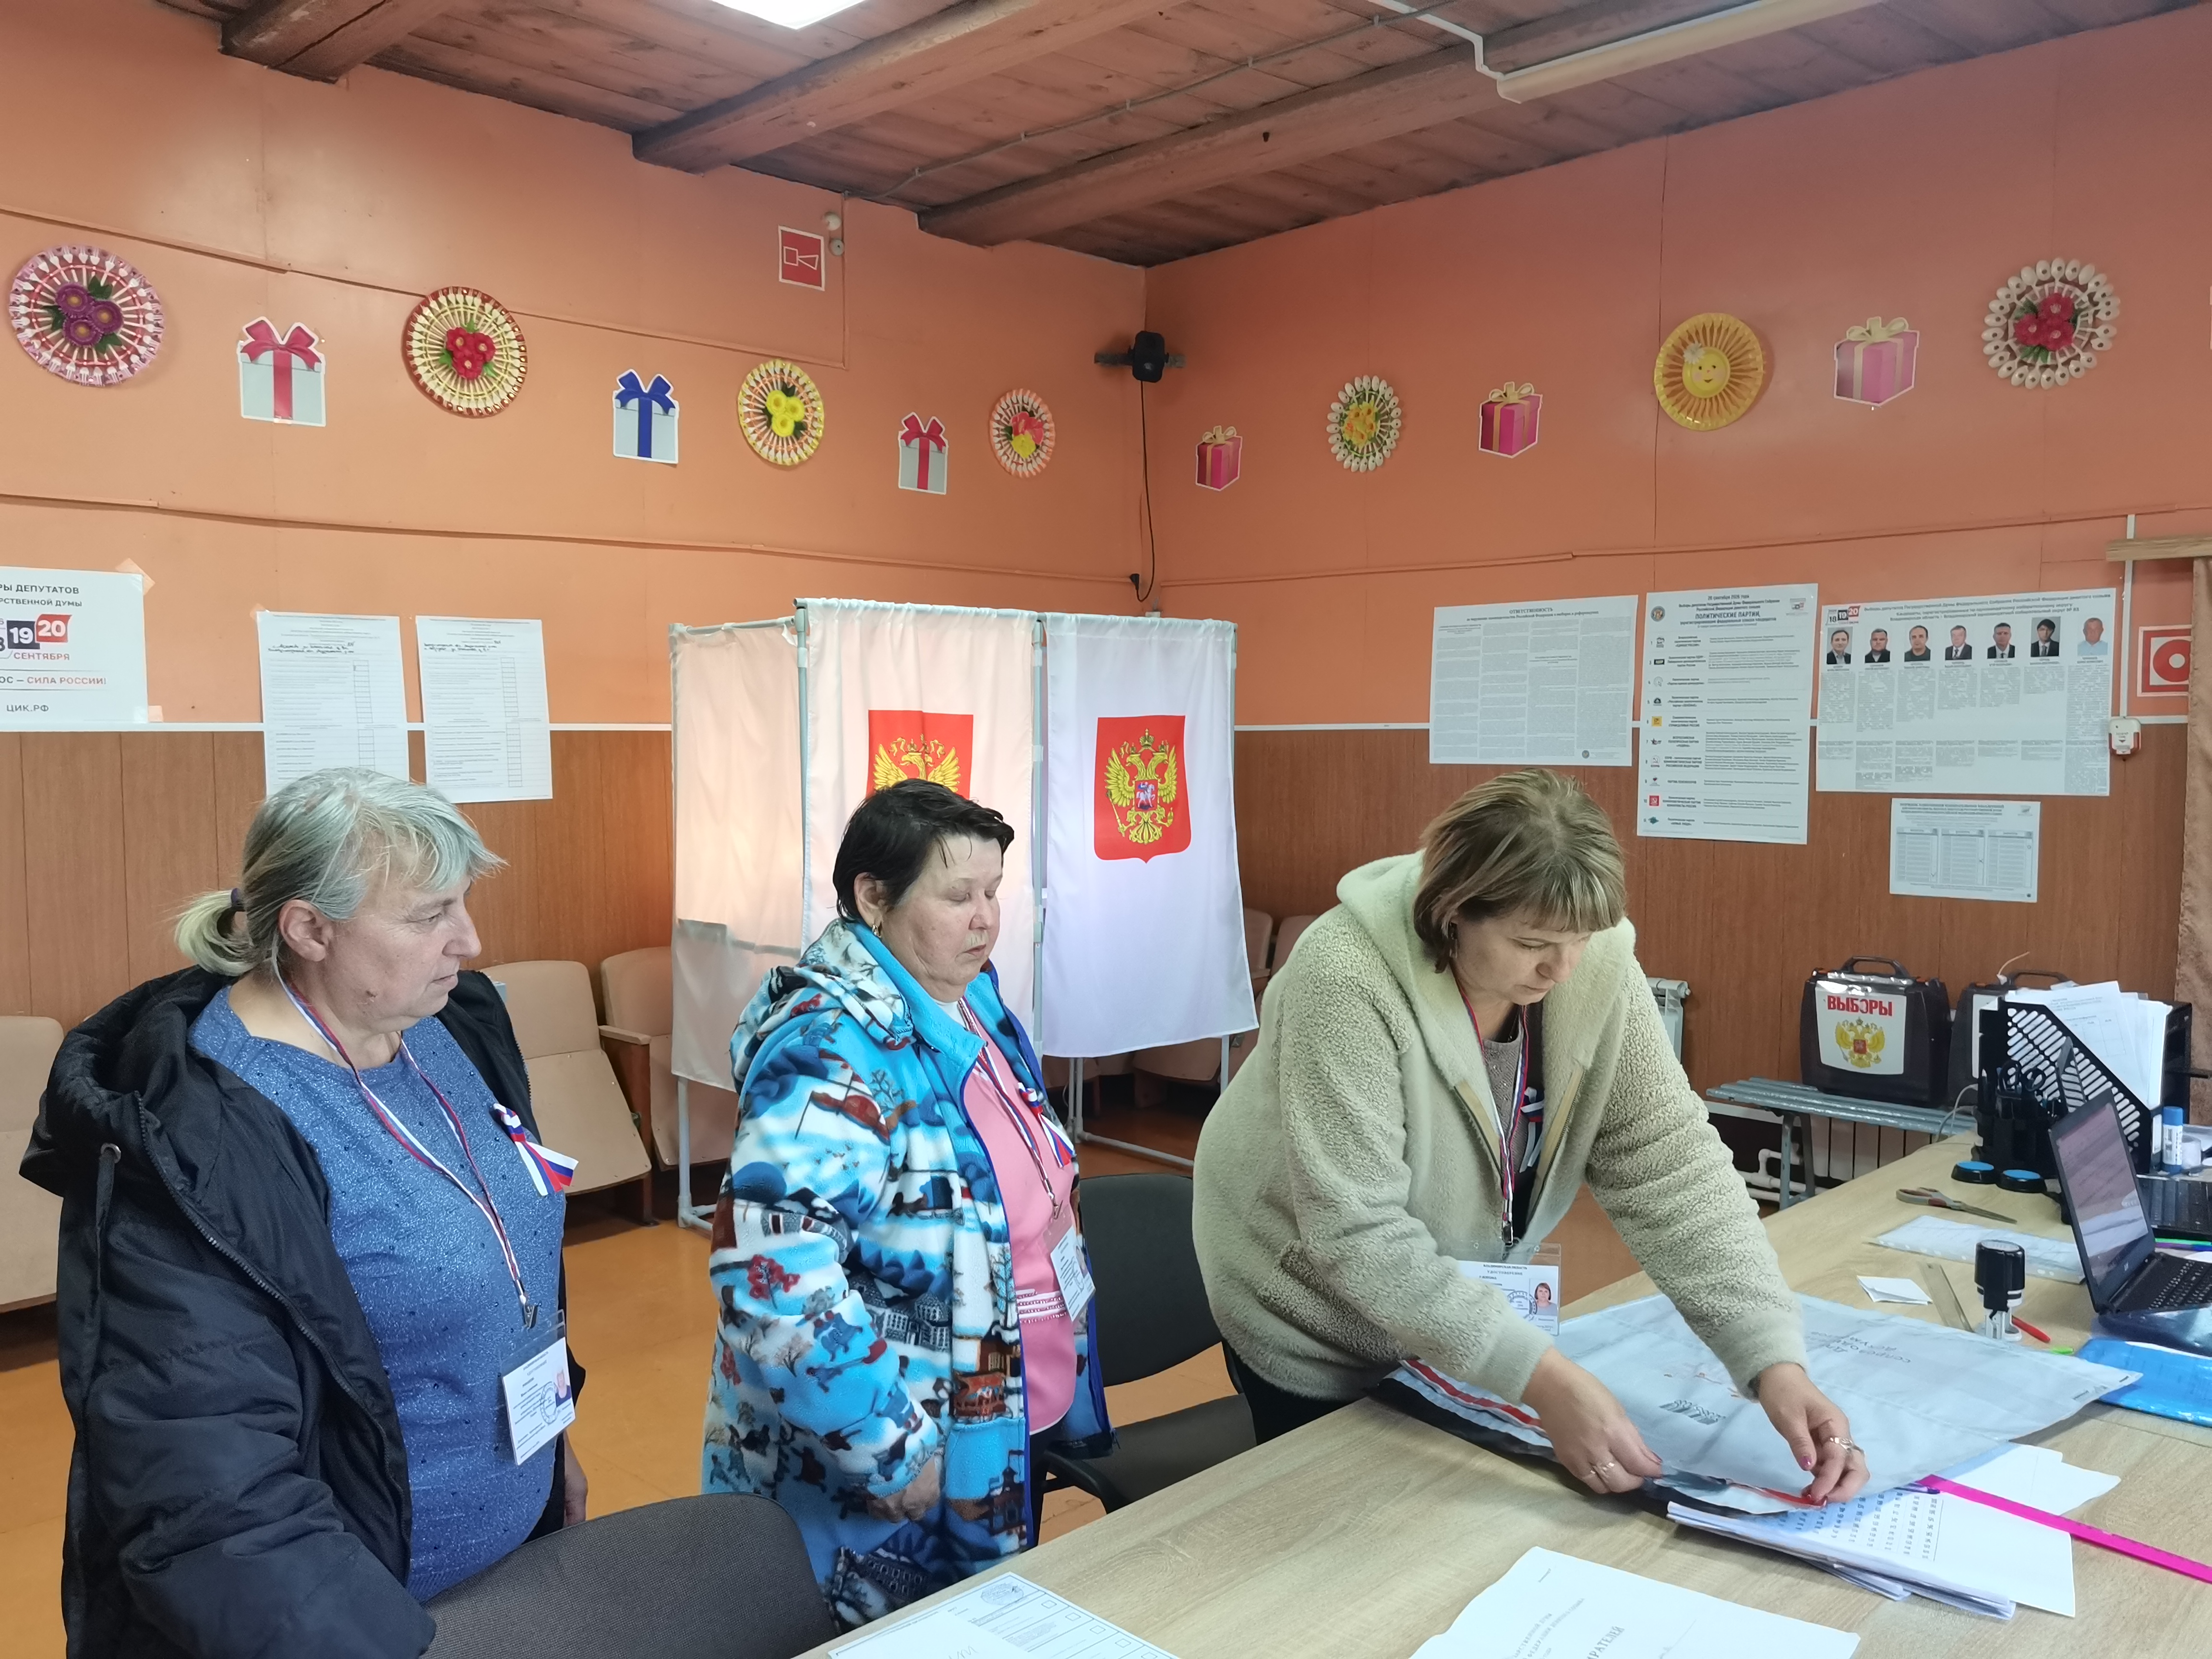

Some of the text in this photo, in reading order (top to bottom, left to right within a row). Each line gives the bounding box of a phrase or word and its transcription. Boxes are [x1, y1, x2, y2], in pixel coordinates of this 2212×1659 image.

[16, 585, 79, 594] ДЕПУТАТОВ
[38, 620, 66, 637] 20
[10, 627, 33, 644] 19
[14, 652, 70, 661] СЕНТЯБРЯ
[7, 704, 49, 712] ЦИК.РФ
[1827, 995, 1892, 1016] ВЫБОРЫ
